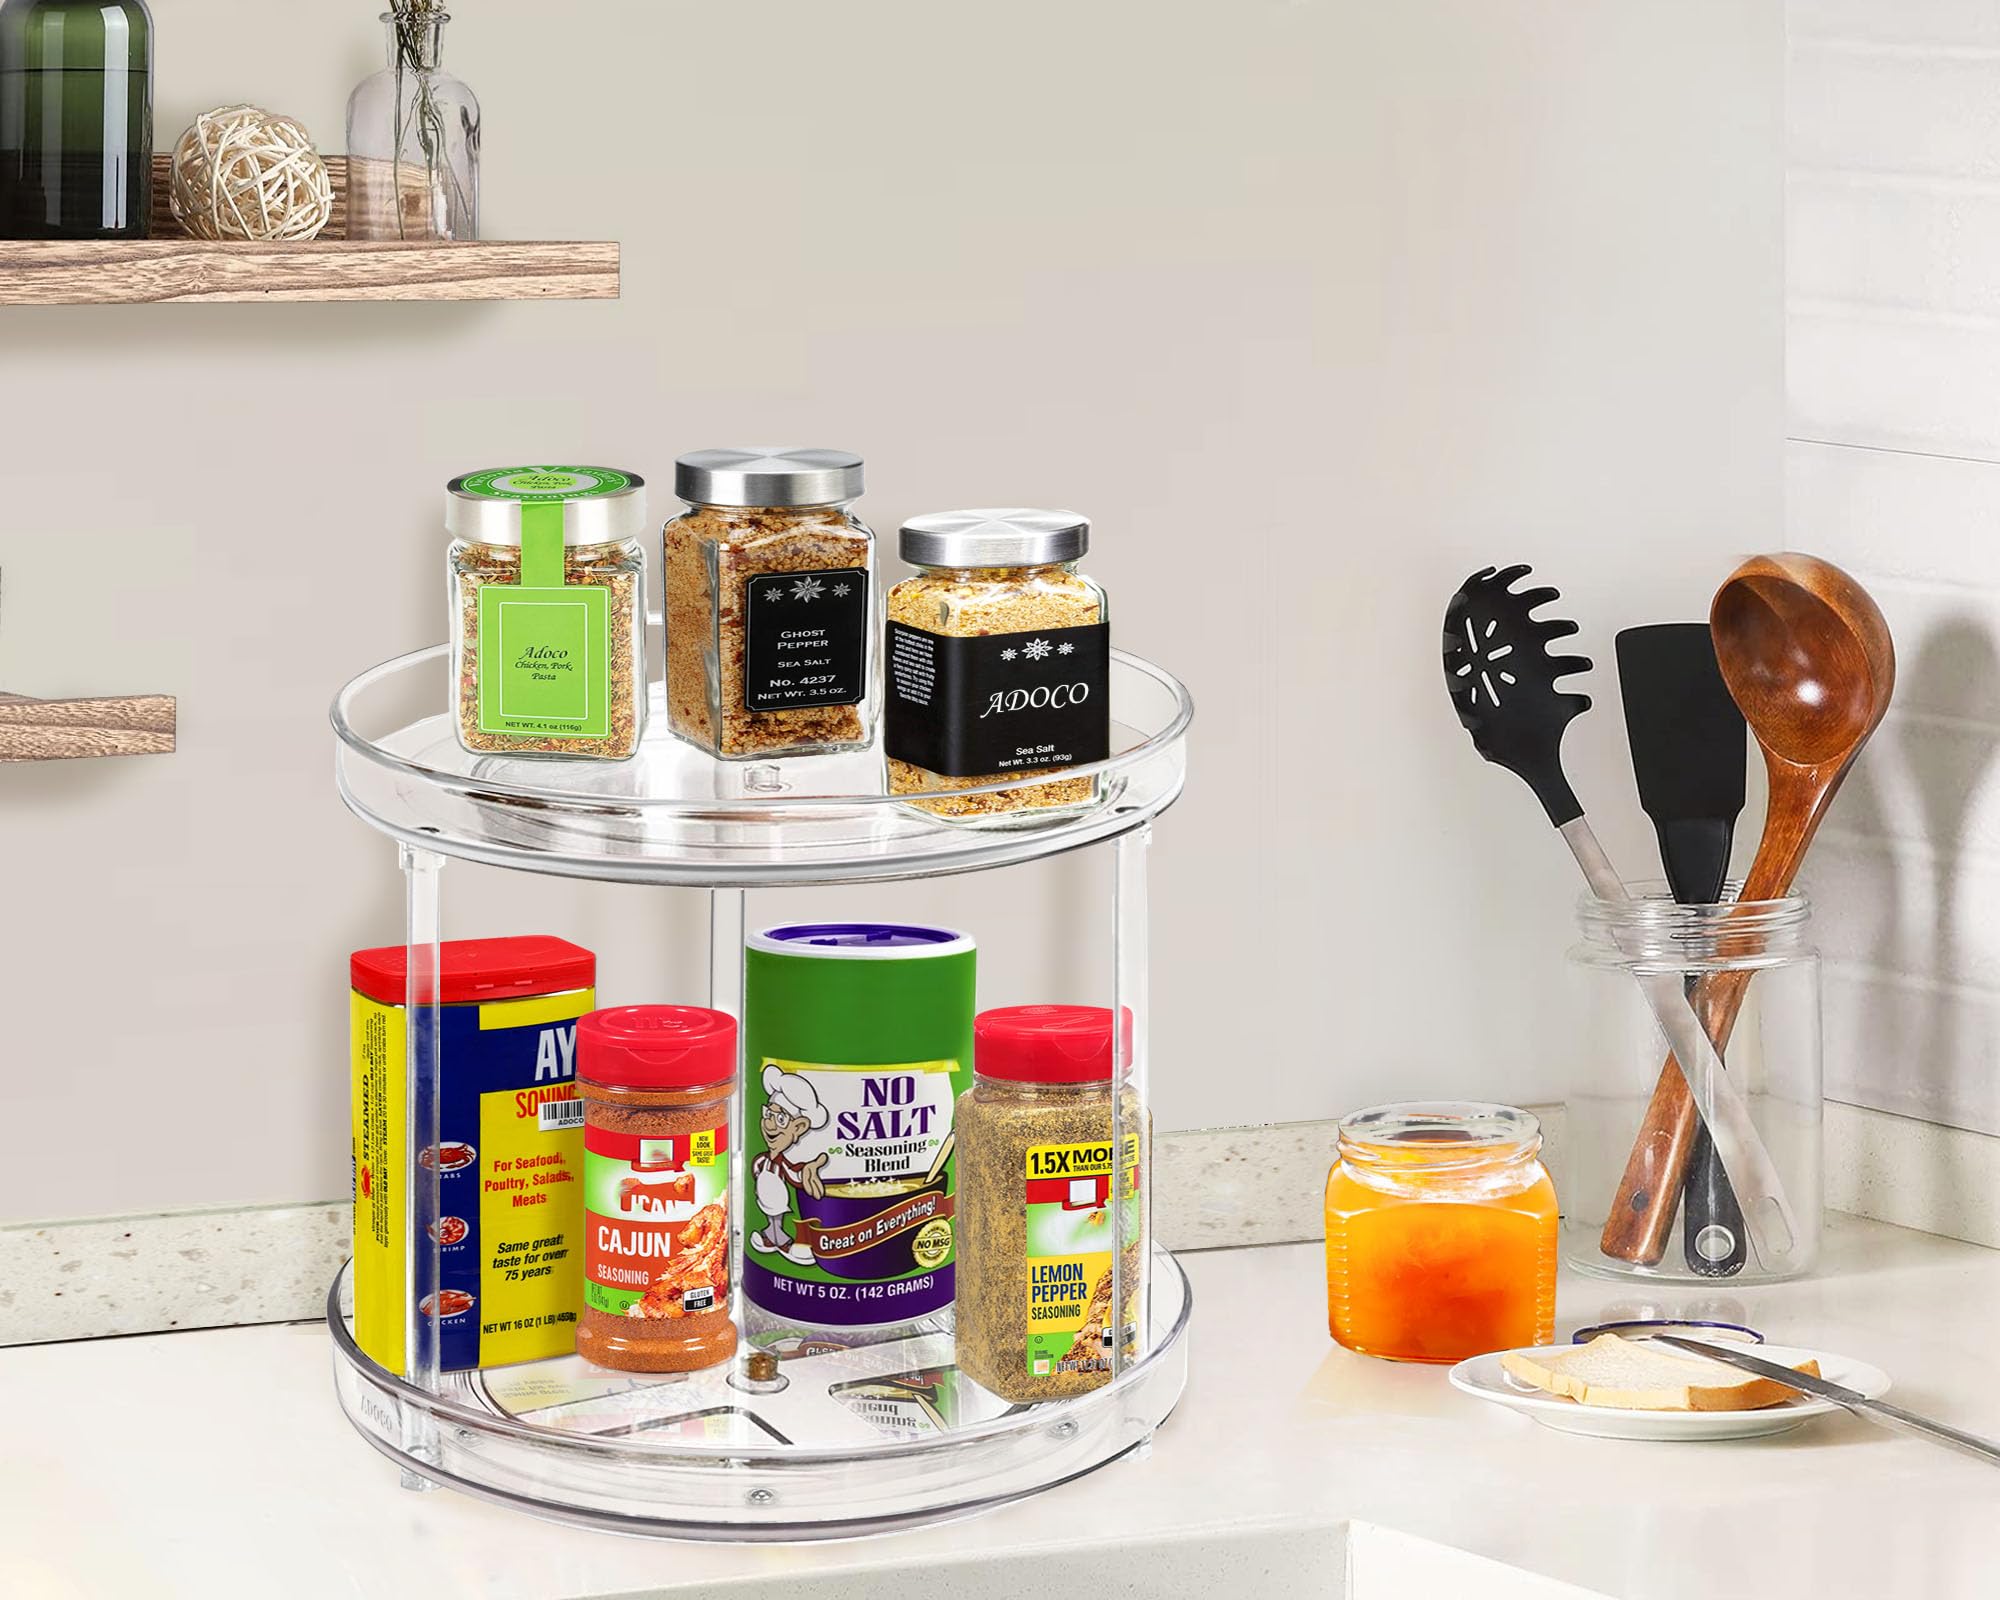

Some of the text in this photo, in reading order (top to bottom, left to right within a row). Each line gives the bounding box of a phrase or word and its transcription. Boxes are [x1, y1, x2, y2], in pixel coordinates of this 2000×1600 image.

[780, 629, 826, 639] GHOST
[777, 640, 829, 650] PEPPER
[518, 646, 568, 660] Adoco
[514, 661, 574, 671] Chicken, Pork,
[804, 658, 831, 666] SALT
[530, 671, 557, 681] Pasta
[769, 674, 836, 687] NO. 4237
[758, 692, 782, 700] NET
[784, 690, 806, 698] WT.
[809, 688, 827, 696] 3.5
[979, 682, 1089, 719] ADOCO
[522, 721, 535, 729] WT.
[536, 722, 548, 730] 4.1
[1016, 744, 1055, 756] Sea Salt
[1013, 758, 1025, 766] Wt.
[1026, 756, 1039, 765] 3.3
[1052, 753, 1072, 763] (93g)
[534, 1024, 577, 1081] AY
[860, 1075, 915, 1107] NO
[362, 1074, 370, 1161] STEAMED
[558, 1117, 585, 1126] ADOCO
[837, 1104, 936, 1141] SALT
[845, 1139, 927, 1157] Seasoning
[493, 1160, 513, 1173] For
[865, 1156, 910, 1173] Blend
[1030, 1151, 1070, 1174] 1.5X
[1073, 1164, 1089, 1172] THAN
[1089, 1163, 1101, 1171] OUR
[437, 1172, 461, 1180] ABS
[484, 1175, 529, 1192] Poultry,
[512, 1193, 547, 1208] Meats
[819, 1235, 855, 1251] Great
[858, 1228, 873, 1241] on
[876, 1197, 936, 1236] Everything!
[433, 1245, 465, 1253] RIMP
[497, 1234, 564, 1254] Same great
[598, 1225, 671, 1258] CAJUN
[917, 1237, 950, 1249] NO MSG
[493, 1256, 521, 1269] taste
[524, 1252, 540, 1265] for
[505, 1265, 553, 1282] 75 years
[597, 1263, 649, 1285] SEASONING
[1031, 1263, 1083, 1284] LEMON
[690, 1289, 710, 1298] GLUTEN
[773, 1275, 934, 1301] NET WT 5 OZ. (142 GRAMS)
[1031, 1282, 1087, 1303] PEPPER
[694, 1300, 707, 1308] FREE
[1031, 1304, 1081, 1320] SEASONING
[427, 1318, 466, 1327] CCKEN
[483, 1323, 498, 1334] NET
[499, 1321, 512, 1332] WT
[513, 1320, 523, 1329] 16
[523, 1318, 535, 1328] OZ
[535, 1316, 541, 1328] (1
